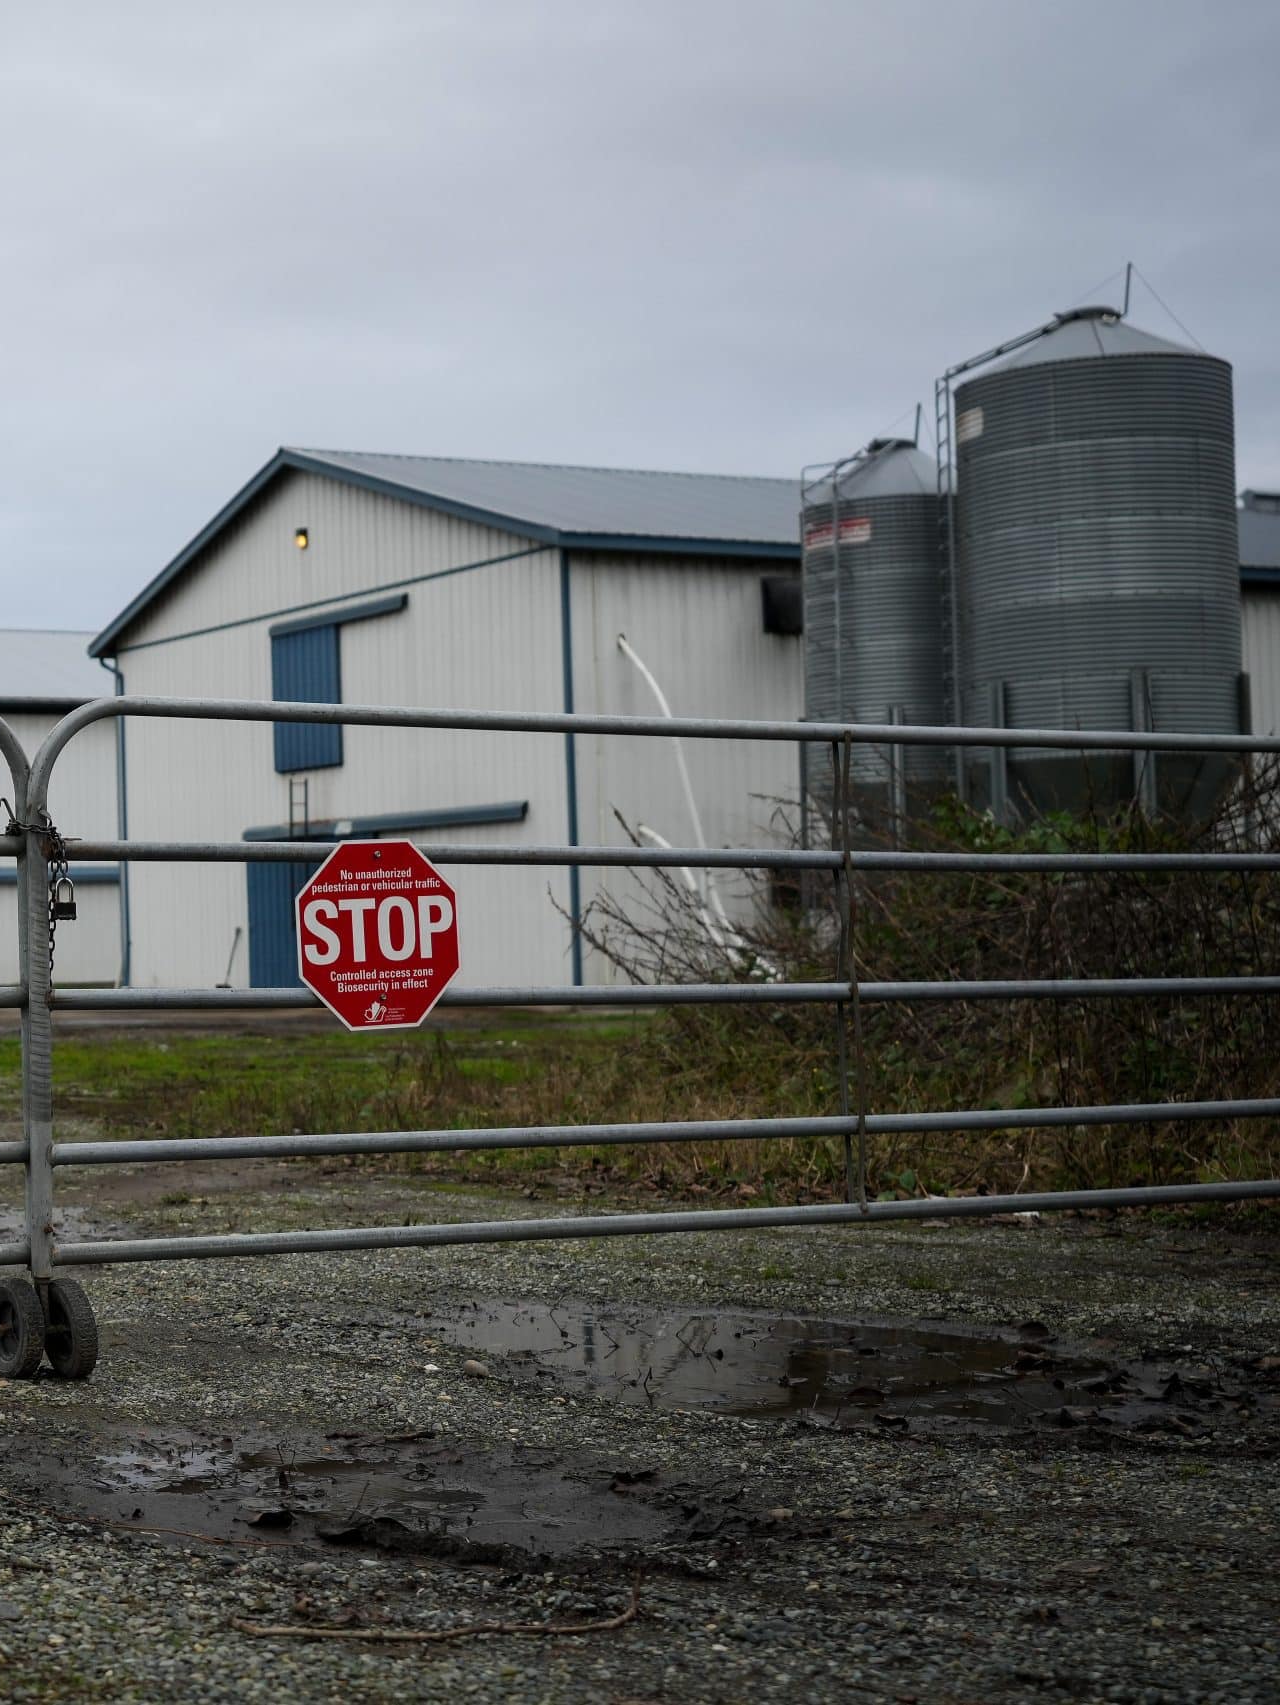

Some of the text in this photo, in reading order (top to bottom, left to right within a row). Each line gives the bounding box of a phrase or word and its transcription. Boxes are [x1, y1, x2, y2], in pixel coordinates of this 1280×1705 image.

[340, 867, 411, 880] No unauthorized
[311, 879, 440, 895] pedestrian or vehicular traffic
[303, 895, 454, 966] STOP
[330, 967, 433, 982] Controlled access zone
[337, 979, 428, 993] Biosecurity in effect
